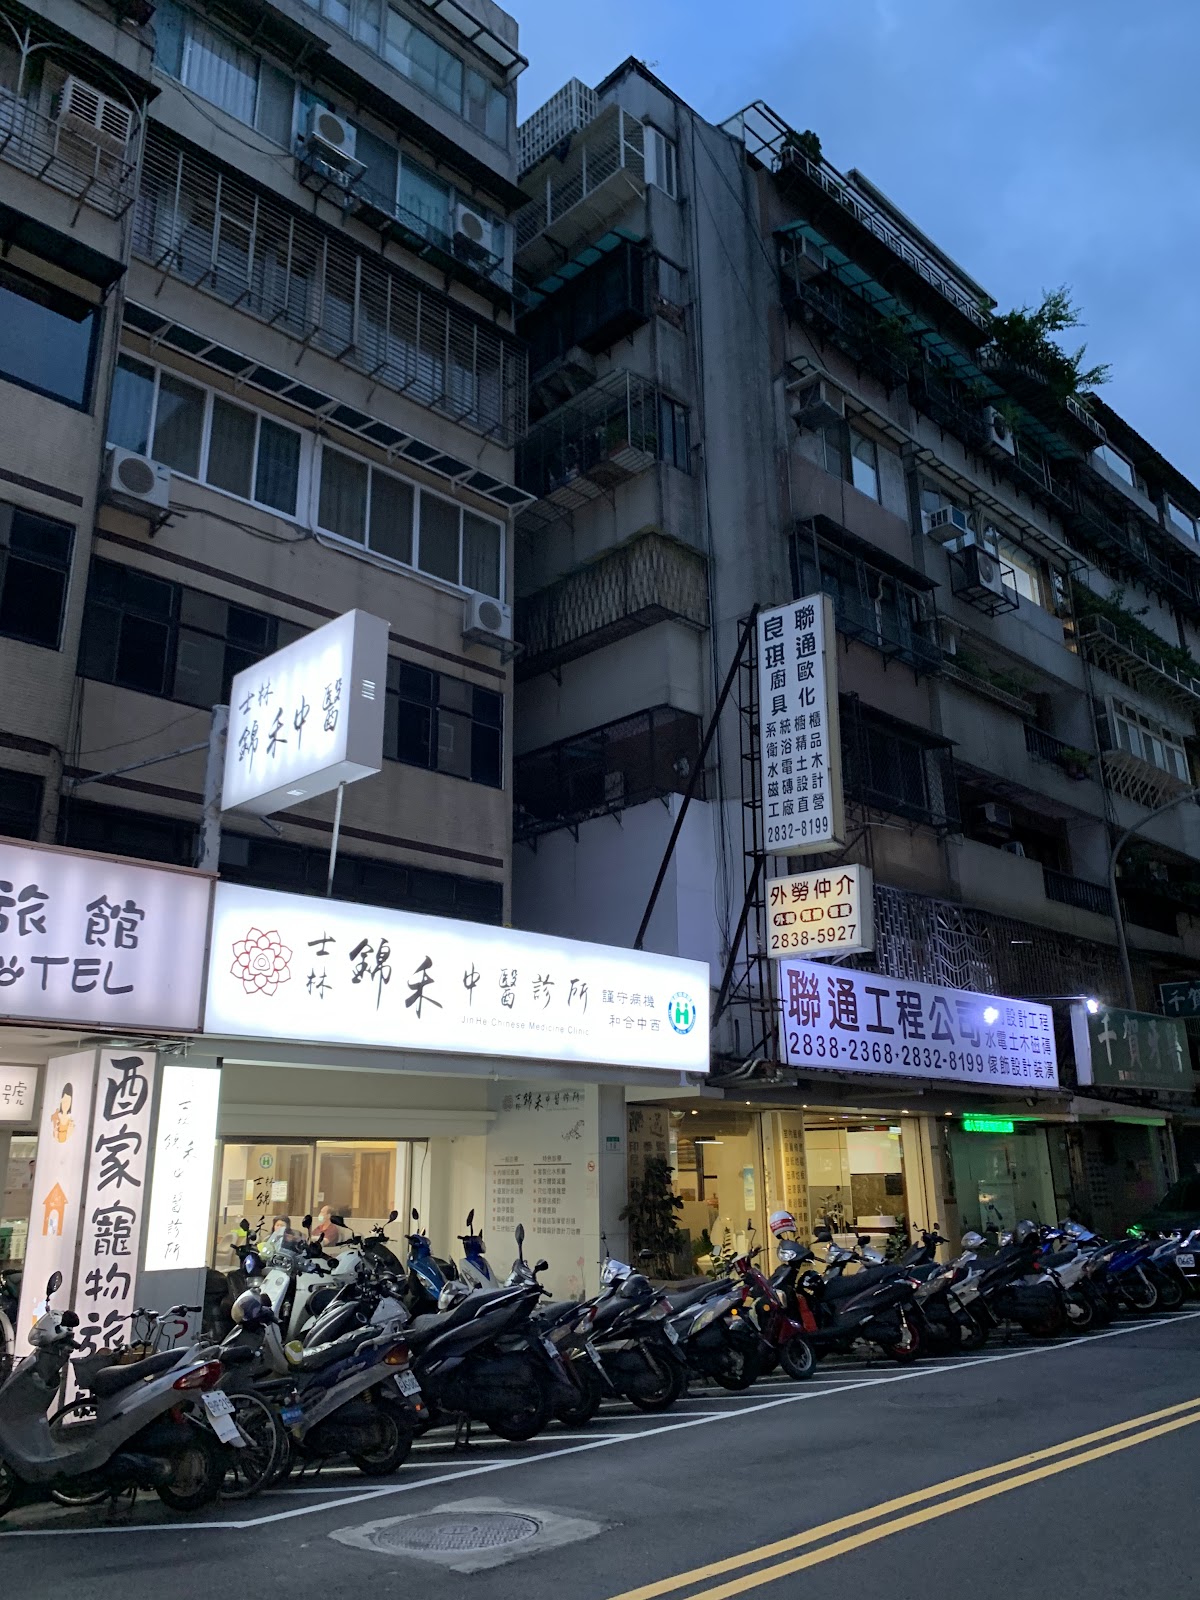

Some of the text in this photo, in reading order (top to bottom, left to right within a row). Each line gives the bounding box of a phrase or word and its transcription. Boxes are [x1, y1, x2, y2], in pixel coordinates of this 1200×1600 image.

[763, 615, 788, 717] 良琪廚具
[794, 603, 816, 709] 聯通歐化
[767, 752, 824, 779] 水電土木
[767, 772, 824, 798] 磁磚設計
[768, 792, 825, 819] 工廠直營
[767, 816, 829, 843] 2832-8199
[770, 874, 855, 906] 外勞仲介
[771, 924, 857, 949] 2838-5927
[602, 988, 656, 1009] 謹守病機
[786, 968, 981, 1048] 聯通工程公司
[491, 1017, 526, 1029] Chinese
[528, 1021, 565, 1034] Medicine
[567, 1025, 589, 1036] Clinic
[608, 1013, 662, 1032] 和合中西
